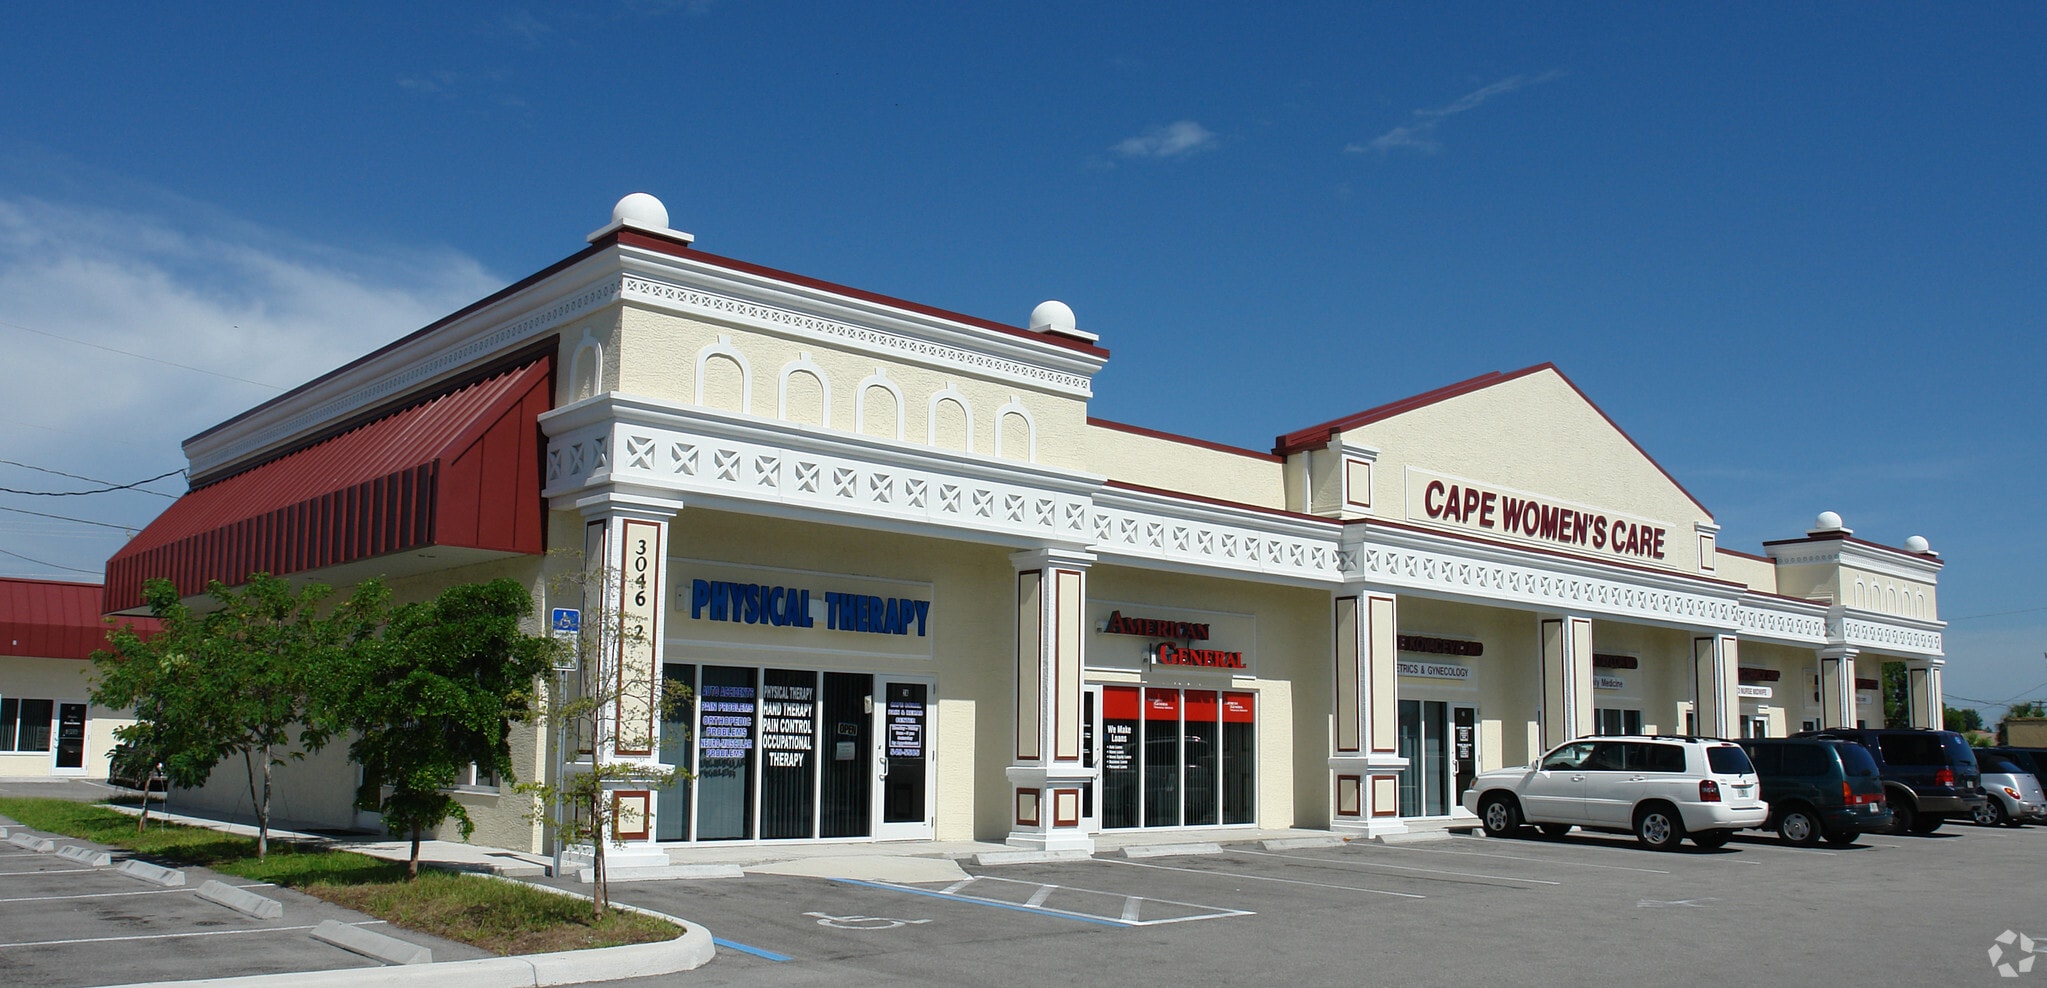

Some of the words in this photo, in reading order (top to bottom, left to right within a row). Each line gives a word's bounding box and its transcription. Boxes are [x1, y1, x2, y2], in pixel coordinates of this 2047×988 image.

[1425, 480, 1497, 528] CAPE
[1502, 495, 1608, 549] WOMEN'S
[1611, 520, 1666, 560] CARE
[635, 539, 647, 606] 3046
[691, 578, 814, 628] PHYSICAL
[825, 591, 930, 637] THERAPY
[1104, 609, 1210, 641] AMERICAN
[1155, 641, 1247, 669] GENERAL
[1420, 665, 1426, 674] &
[1428, 666, 1469, 677] GYNECOLOGY
[1601, 678, 1623, 689] Medicine
[702, 685, 719, 697] AUTO
[721, 686, 754, 698] ACCIDENTS
[764, 685, 788, 699] PHYSICAL
[789, 686, 813, 700] THERAPY
[701, 701, 717, 712] PAIN
[718, 702, 754, 713] PROBLEMS
[763, 702, 782, 716] HAND
[783, 703, 812, 718] THERAPY
[703, 716, 752, 727] ORTHOPEDIC
[762, 718, 779, 733] PAIN
[780, 719, 812, 734] CONTROL
[706, 727, 748, 738] PROBLEMS
[839, 723, 857, 736] OPEN
[1107, 725, 1116, 734] We
[1117, 725, 1131, 734] Make
[762, 734, 811, 750] OCCUPATIONAL
[1111, 734, 1128, 742] Loans
[706, 749, 745, 759] PROBLEMS
[769, 752, 804, 767] THERAPY
